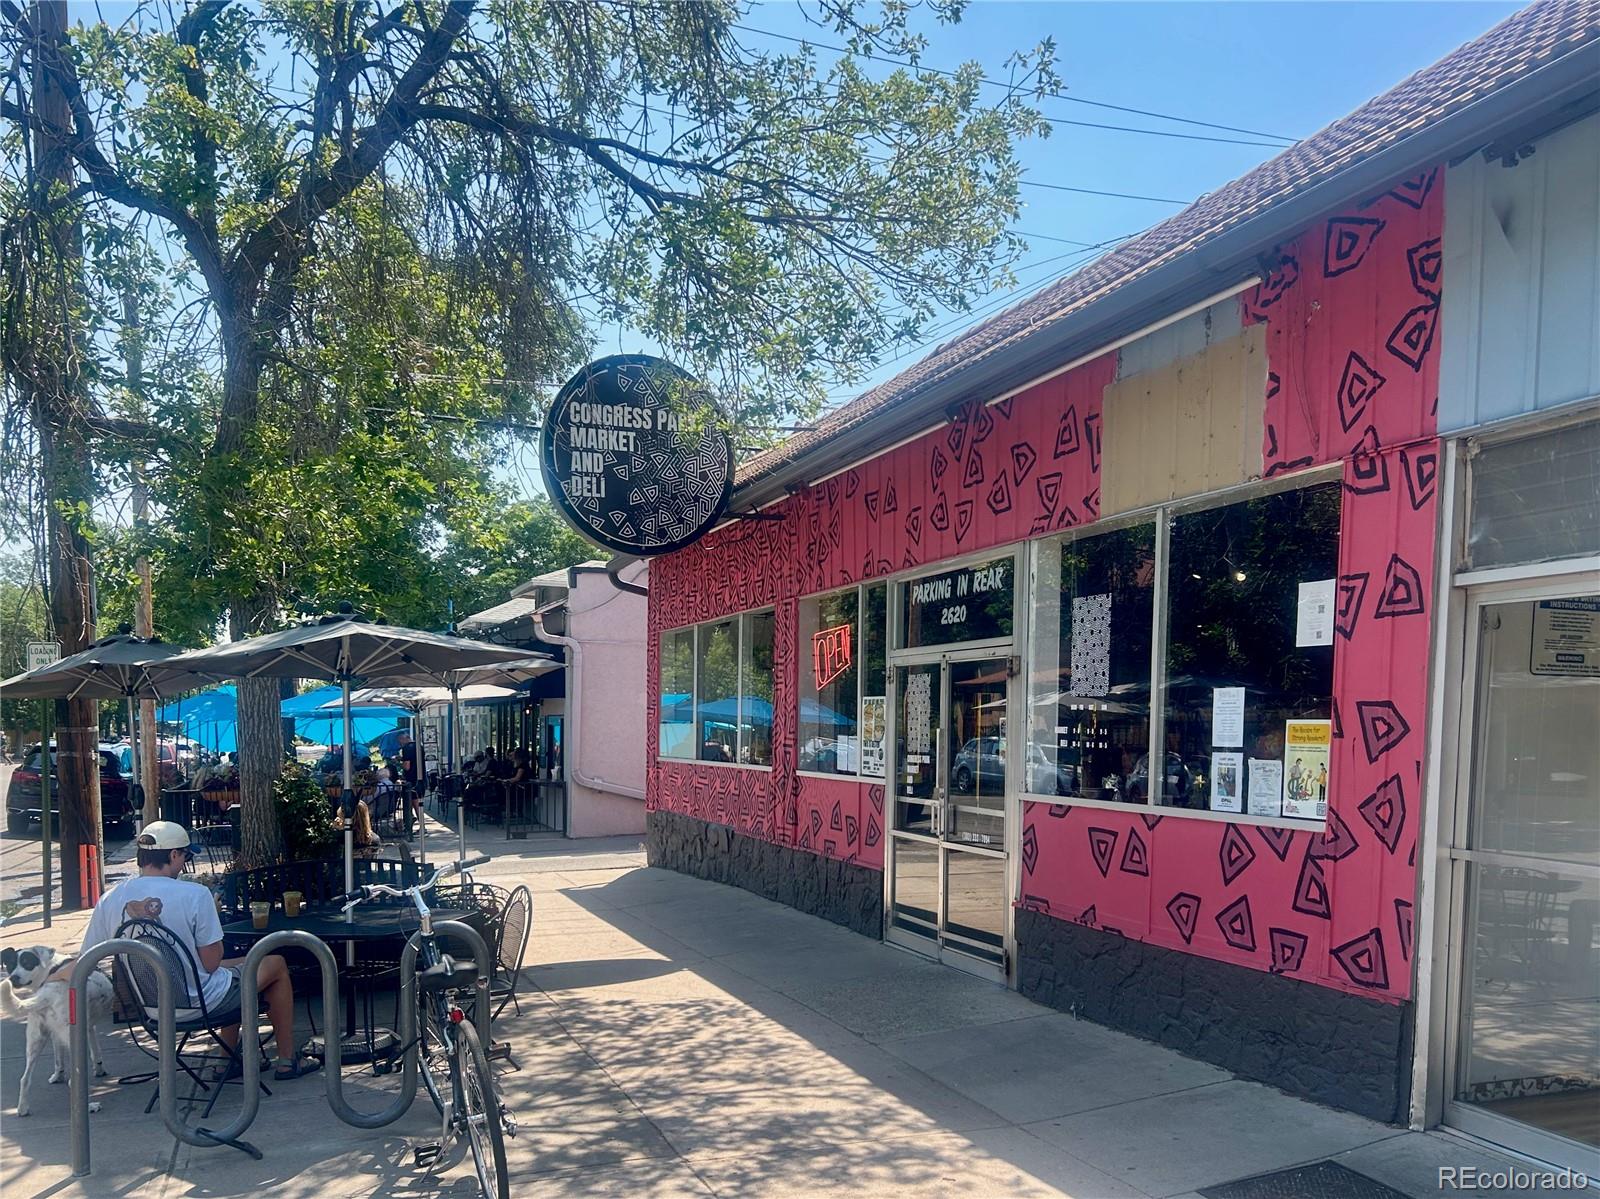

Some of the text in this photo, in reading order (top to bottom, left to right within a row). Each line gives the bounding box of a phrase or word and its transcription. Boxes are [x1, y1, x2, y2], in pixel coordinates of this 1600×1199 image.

[569, 401, 697, 432] CONGRESS PA
[570, 426, 636, 452] MARKET
[571, 451, 604, 474] AND
[571, 474, 606, 498] DELI
[912, 566, 1004, 606] PARKING IN REAR
[940, 604, 967, 625] 2620
[1550, 600, 1597, 610] INSTRUCTIONS
[816, 627, 850, 685] OPEN
